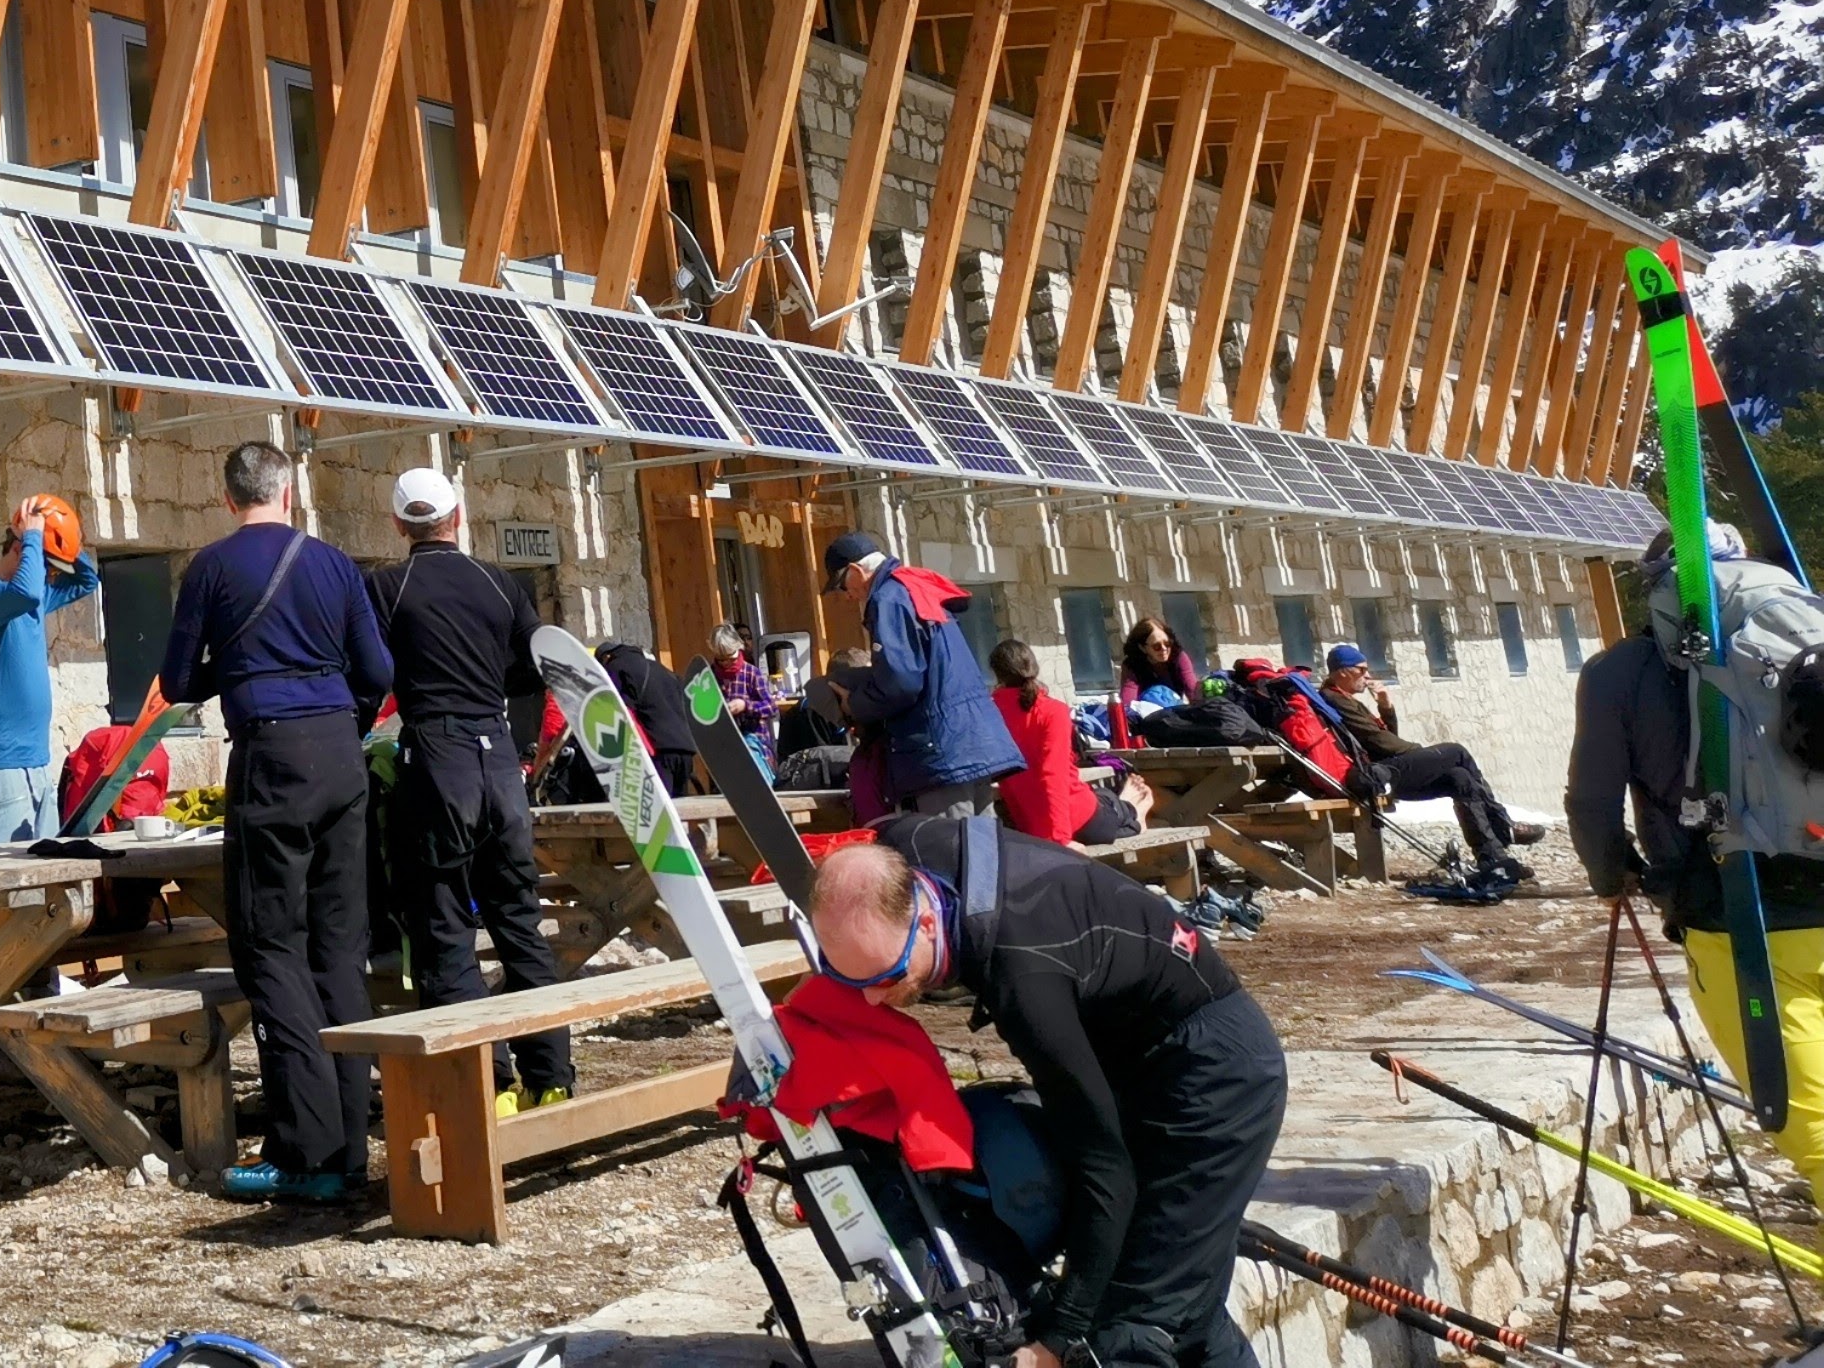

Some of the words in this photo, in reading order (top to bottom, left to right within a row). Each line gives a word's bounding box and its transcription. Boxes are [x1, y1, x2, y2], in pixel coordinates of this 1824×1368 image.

[504, 528, 552, 557] ENTREE
[737, 511, 785, 548] BAR
[639, 770, 655, 828] VERTEX
